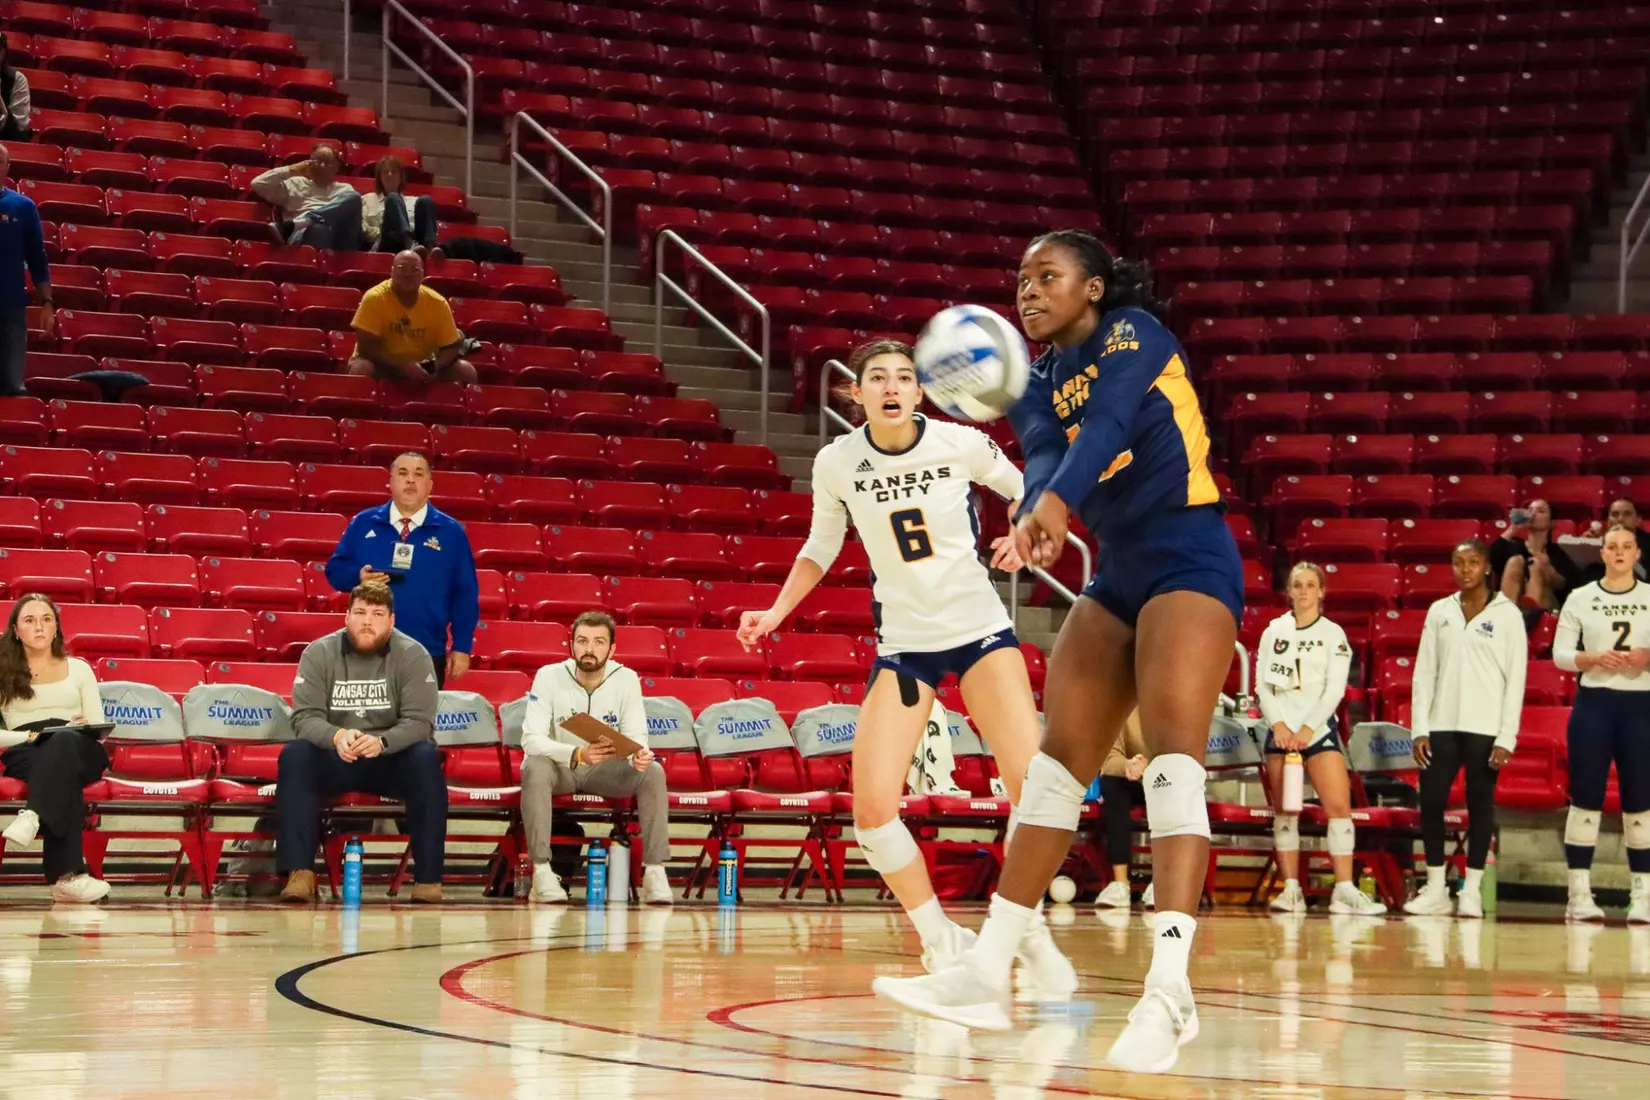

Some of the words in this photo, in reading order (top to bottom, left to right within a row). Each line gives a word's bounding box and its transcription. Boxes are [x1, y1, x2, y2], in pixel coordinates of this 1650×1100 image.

[853, 466, 951, 492] KANSAS
[875, 483, 931, 503] CITY
[889, 506, 935, 564] 6
[1611, 621, 1632, 652] 2
[332, 684, 368, 699] KANSAS
[368, 682, 387, 698] CITY
[331, 697, 391, 707] VOLLEYBALL
[103, 705, 163, 719] UMMIT
[208, 706, 273, 720] SUMMIT
[223, 719, 261, 727] LEAGUE
[717, 718, 772, 735] SUMMIT
[732, 731, 764, 740] LEAGUE
[143, 786, 178, 795] COYOTES
[469, 791, 501, 801] COYOTES
[572, 794, 604, 803] COYOTES
[678, 796, 708, 805] COYOTES
[780, 798, 809, 806] COYOTES
